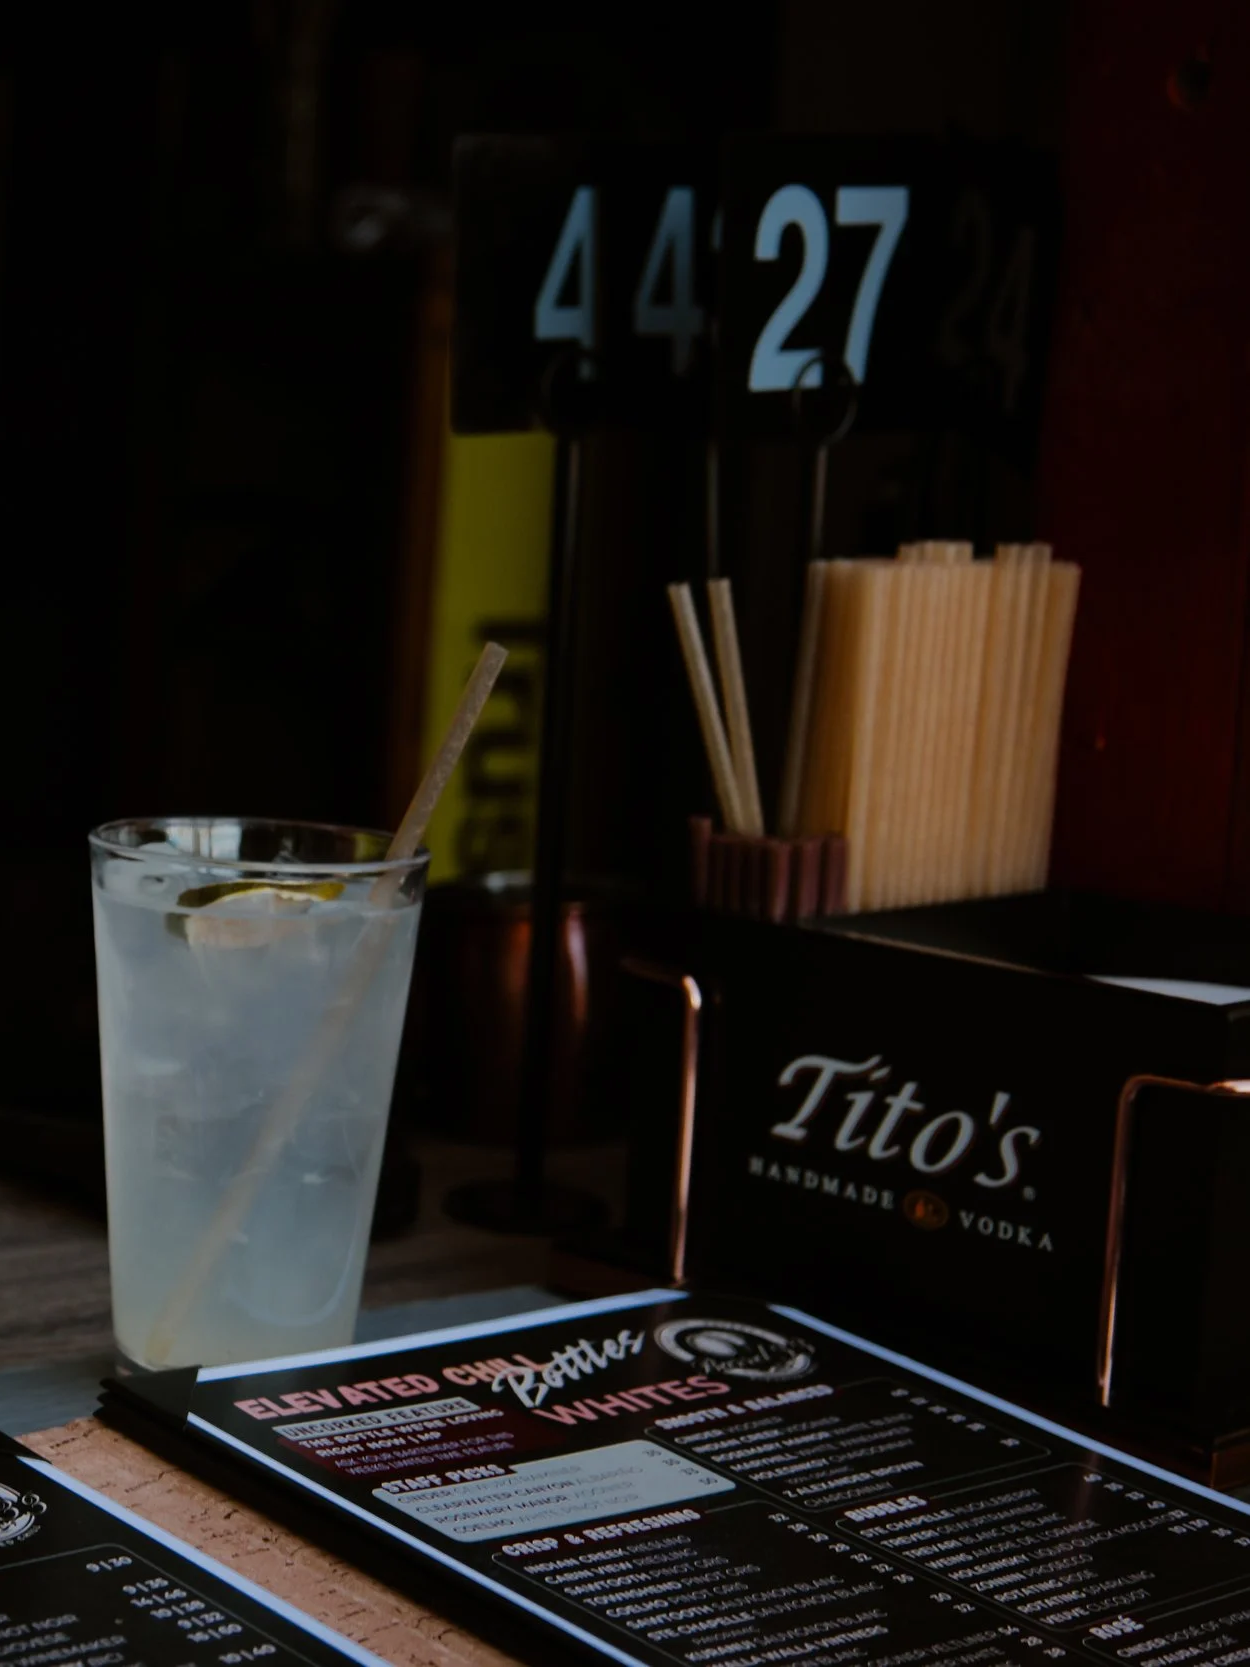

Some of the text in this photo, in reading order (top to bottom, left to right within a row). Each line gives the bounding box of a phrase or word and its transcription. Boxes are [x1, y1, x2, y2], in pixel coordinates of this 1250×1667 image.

[748, 183, 909, 393] 27
[770, 1055, 1040, 1188] Tito's
[749, 1156, 1054, 1252] HANDMADE VODKA
[491, 1329, 645, 1409] Bottles
[234, 1374, 440, 1420] ELEVATED
[532, 1376, 731, 1425] WHITES
[284, 1400, 470, 1436] UNCORKED FEATURE
[298, 1408, 504, 1448] THE BOTTLE WE'RE LOVING
[316, 1444, 364, 1457] RIGHT
[366, 1436, 406, 1449] NOW
[382, 1464, 506, 1492] STAFF PICKS
[416, 1480, 574, 1514] CLEARWATER CANYON
[434, 1504, 512, 1524] ROSEMARY
[514, 1496, 568, 1509] MANOR
[844, 1496, 926, 1521] BUBBLES
[502, 1508, 700, 1556] CRISP & REFRESHING
[860, 1526, 888, 1538] STE
[886, 1510, 954, 1530] CHAPELLE
[958, 1528, 1006, 1544] BLANC
[1000, 1524, 1024, 1533] DE
[1020, 1512, 1066, 1528] BLANC
[1016, 1536, 1040, 1545] DE
[524, 1558, 580, 1574] INDIAN
[578, 1548, 630, 1564] CREEK
[626, 1536, 692, 1554] RIESLING
[544, 1548, 698, 1584] CABIN VIEW RIESLING
[564, 1572, 652, 1596] SAWTOOTH
[648, 1562, 694, 1578] PINOT
[694, 1556, 728, 1568] GRIS
[680, 1570, 726, 1586] PINOT
[726, 1564, 760, 1576] GRIS
[994, 1580, 1064, 1602] ROTATING
[606, 1600, 668, 1618] COELHO
[666, 1588, 712, 1604] PINOT
[712, 1582, 748, 1594] GRIS
[626, 1604, 714, 1628] SAWTOOTH
[710, 1586, 798, 1610] SAUVIGNON
[794, 1576, 844, 1592] BLANC
[646, 1582, 884, 1642] STE CHAPELLE SAUVIGNON BLANC
[1016, 1590, 1086, 1614] ROTATING
[1040, 1606, 1090, 1624] VEUVE
[32, 1614, 78, 1630] NOIR
[752, 1620, 840, 1646] SAUVIGNON
[836, 1608, 888, 1626] BLANC
[814, 1624, 888, 1647] VINTNERS
[1088, 1614, 1144, 1640] ROSÉ
